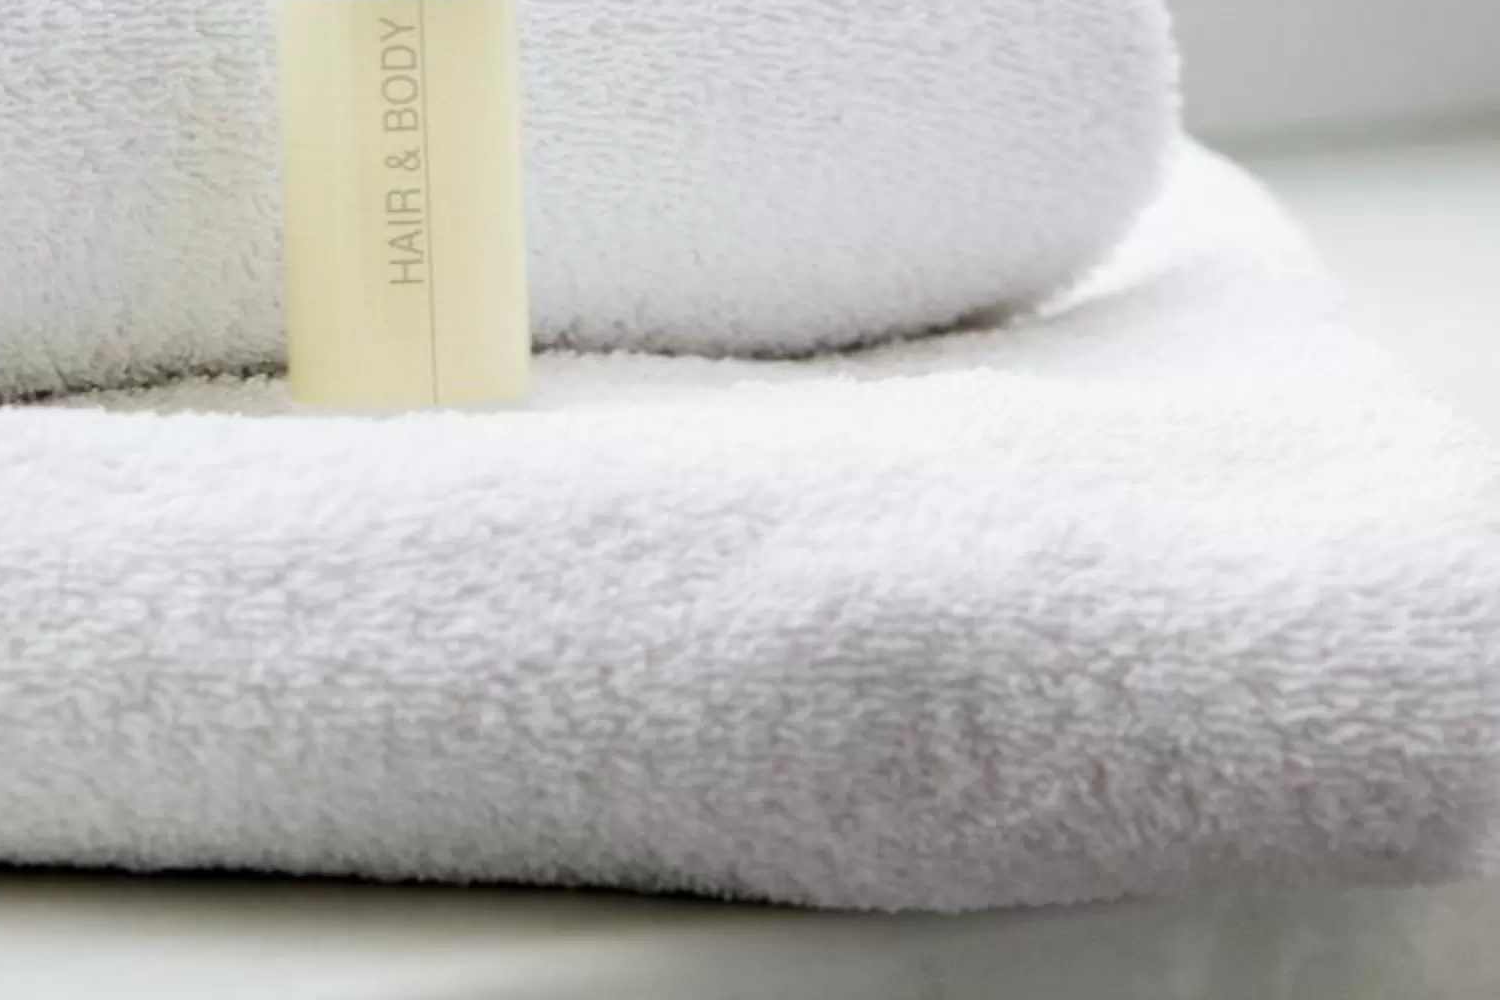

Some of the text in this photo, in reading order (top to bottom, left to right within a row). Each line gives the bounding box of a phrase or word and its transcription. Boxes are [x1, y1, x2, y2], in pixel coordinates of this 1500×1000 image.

[380, 17, 425, 286] HAIR & BODY
